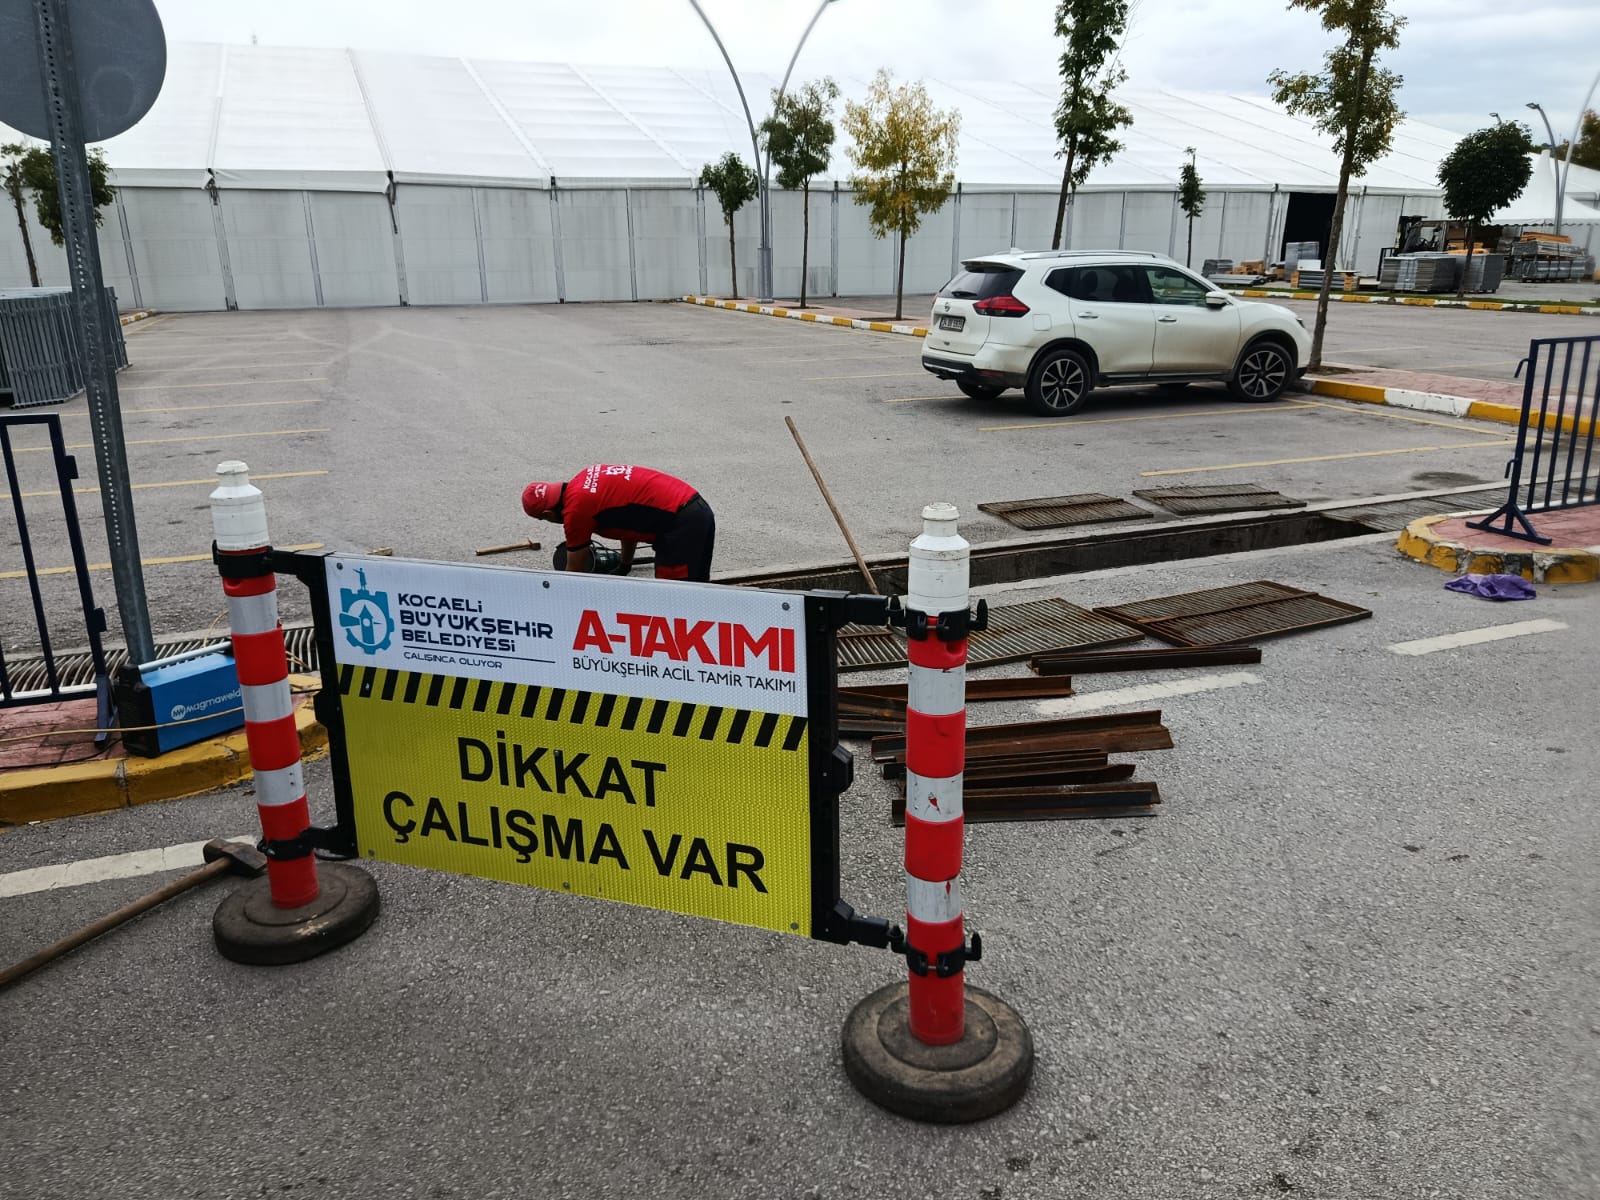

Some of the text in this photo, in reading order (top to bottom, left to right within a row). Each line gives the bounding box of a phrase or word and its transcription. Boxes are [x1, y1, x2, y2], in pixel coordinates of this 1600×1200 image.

[458, 657, 503, 669] OLUYOR
[572, 609, 796, 674] A-TAKIMI
[572, 655, 797, 693] BÜYÜKŞEHİR ACİL TAMİR TAKIMI
[457, 730, 667, 808] DİKKAT
[382, 790, 769, 894] ÇALIŞMA VAR
